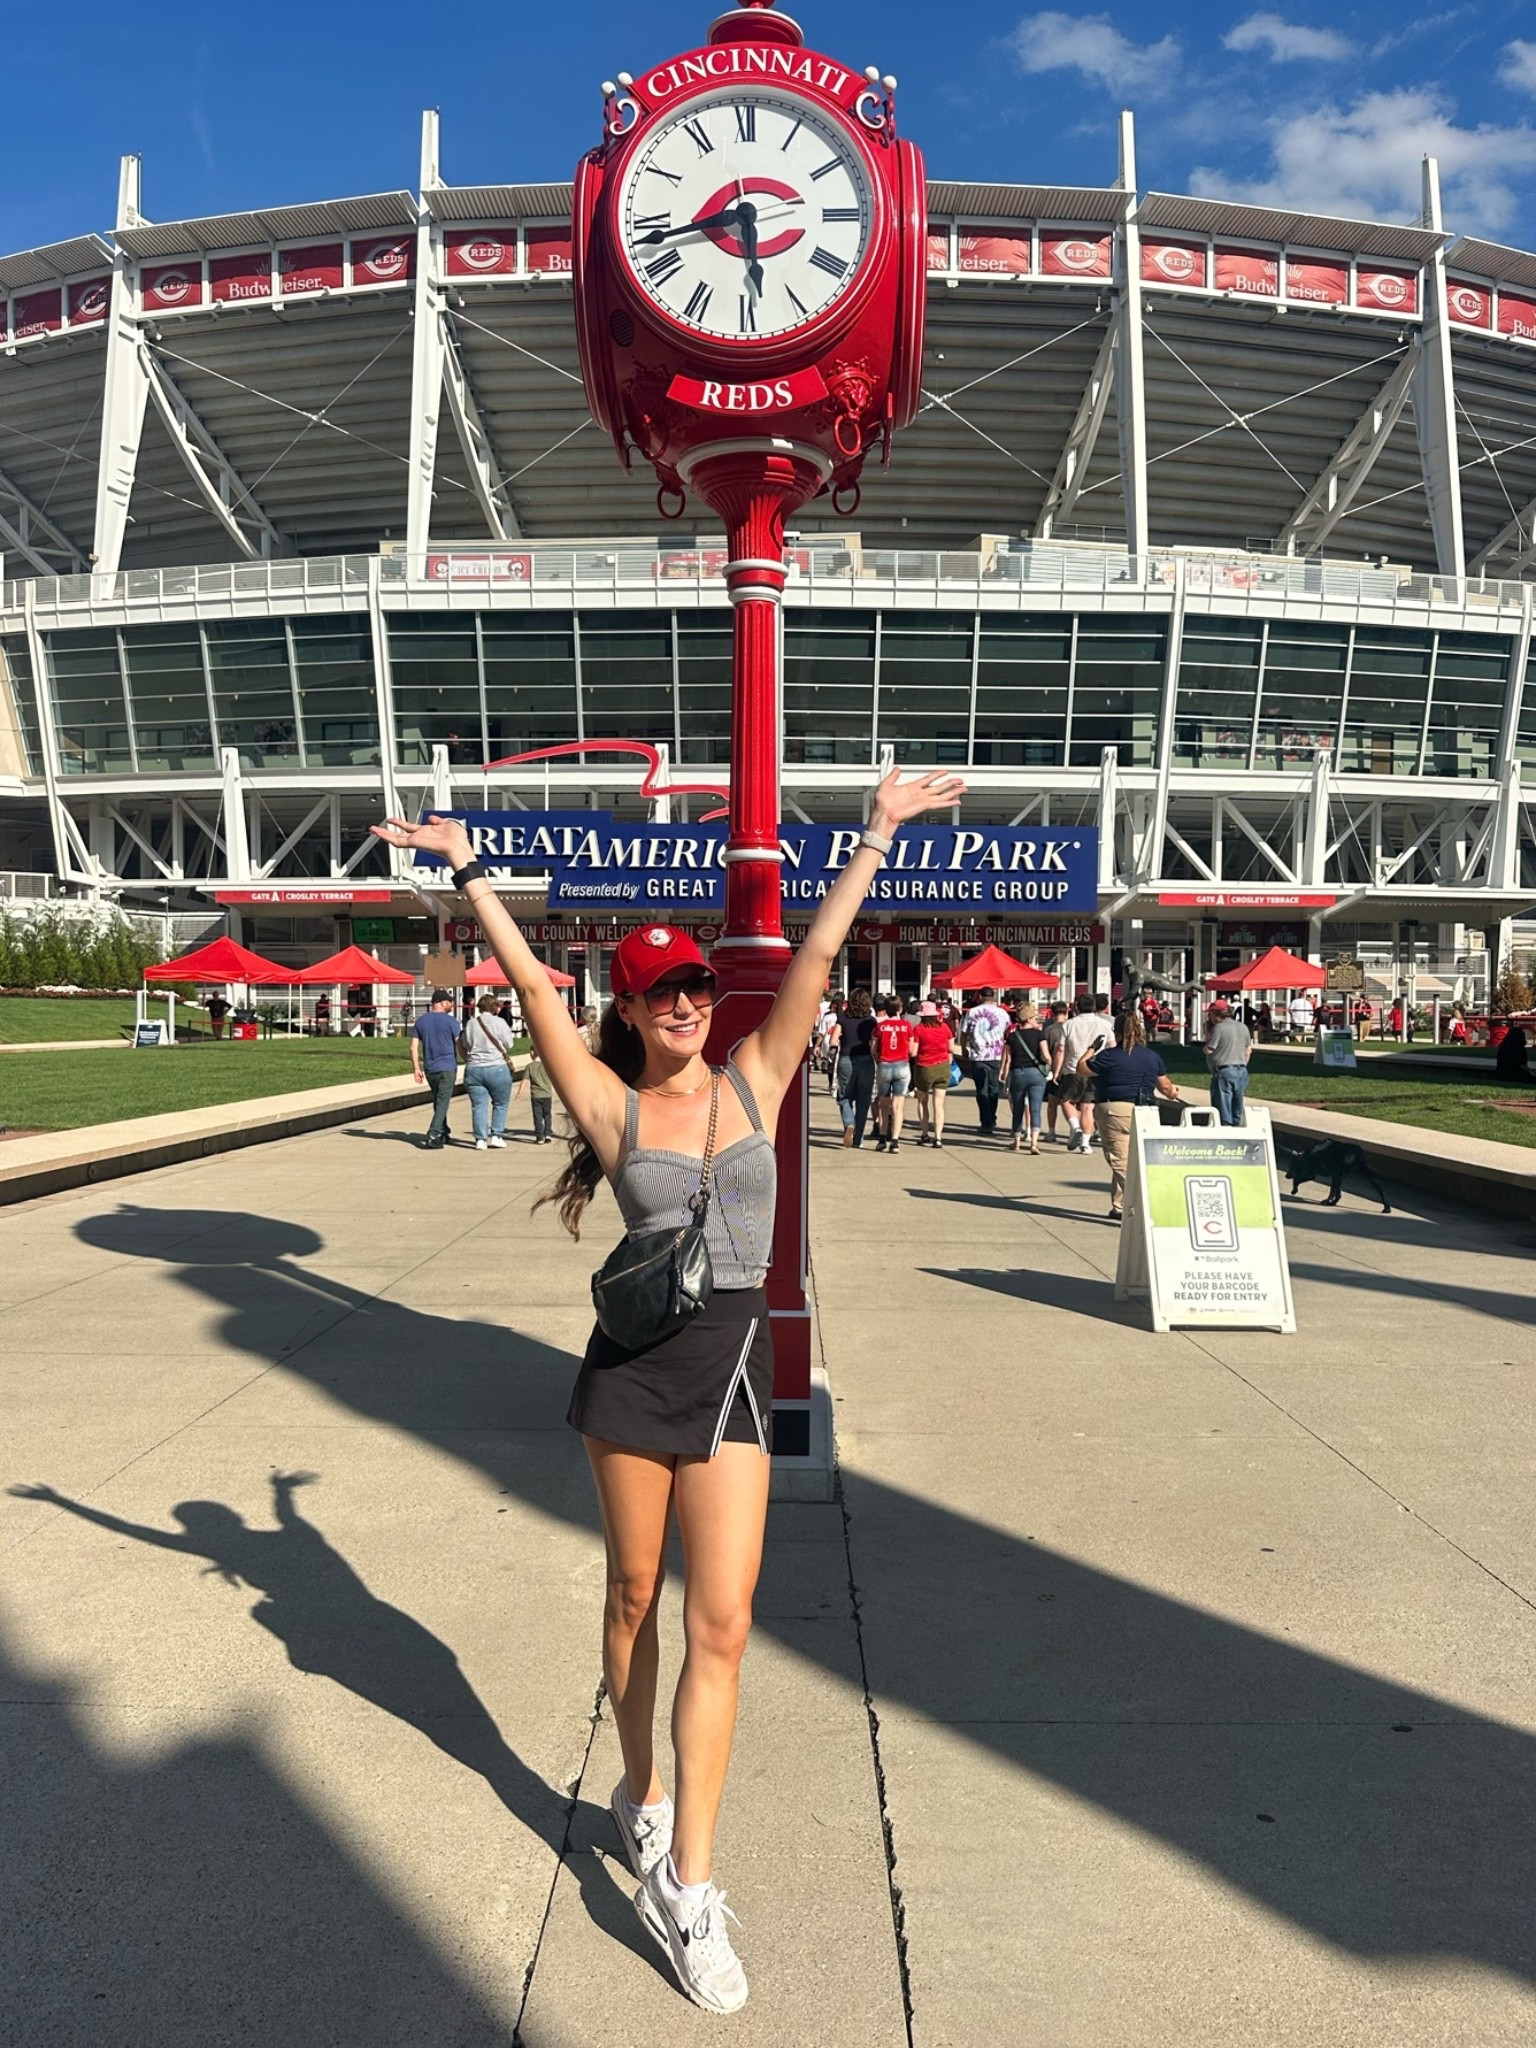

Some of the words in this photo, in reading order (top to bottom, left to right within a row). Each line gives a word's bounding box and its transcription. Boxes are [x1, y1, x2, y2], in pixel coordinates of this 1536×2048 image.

[648, 48, 850, 97] CINCINNATI
[470, 248, 502, 257] REDS
[1066, 249, 1098, 259] REDS
[374, 254, 404, 265] REDS
[1165, 256, 1194, 268] REDS
[162, 282, 190, 292] REDS
[1380, 284, 1406, 295] REDS
[1459, 299, 1482, 311] REDS
[699, 380, 792, 410] REDS
[447, 818, 583, 855] REAT
[566, 829, 807, 868] AMERIN
[945, 831, 1068, 871] PARK
[559, 882, 622, 897] Presented
[622, 882, 640, 899] by
[647, 878, 717, 897] GREAT
[865, 880, 983, 899] NSURANCE
[995, 881, 1069, 900] GROUP
[251, 893, 270, 901] GATE
[271, 891, 280, 901] A
[320, 892, 353, 900] TERRACE
[1196, 895, 1215, 903] GATE
[1216, 894, 1225, 905] A
[1266, 896, 1299, 904] TERRACE
[542, 925, 591, 941] COUNTY
[899, 926, 934, 941] HOME
[939, 926, 953, 941] OF
[958, 926, 980, 941] THE
[985, 926, 1055, 942] CINCINNATI
[1060, 927, 1091, 943] REDS
[1163, 1144, 1213, 1156] Welcome
[1215, 1145, 1248, 1156] Back!
[1206, 1255, 1239, 1263] Ballpark
[1184, 1271, 1222, 1280] PLEASE
[1225, 1272, 1253, 1280] HAVE
[1180, 1282, 1209, 1290] YOUR
[1211, 1282, 1259, 1291] BARCODE
[1174, 1292, 1208, 1300] READY
[1211, 1292, 1231, 1300] FOR
[1233, 1293, 1268, 1301] ENTRY
